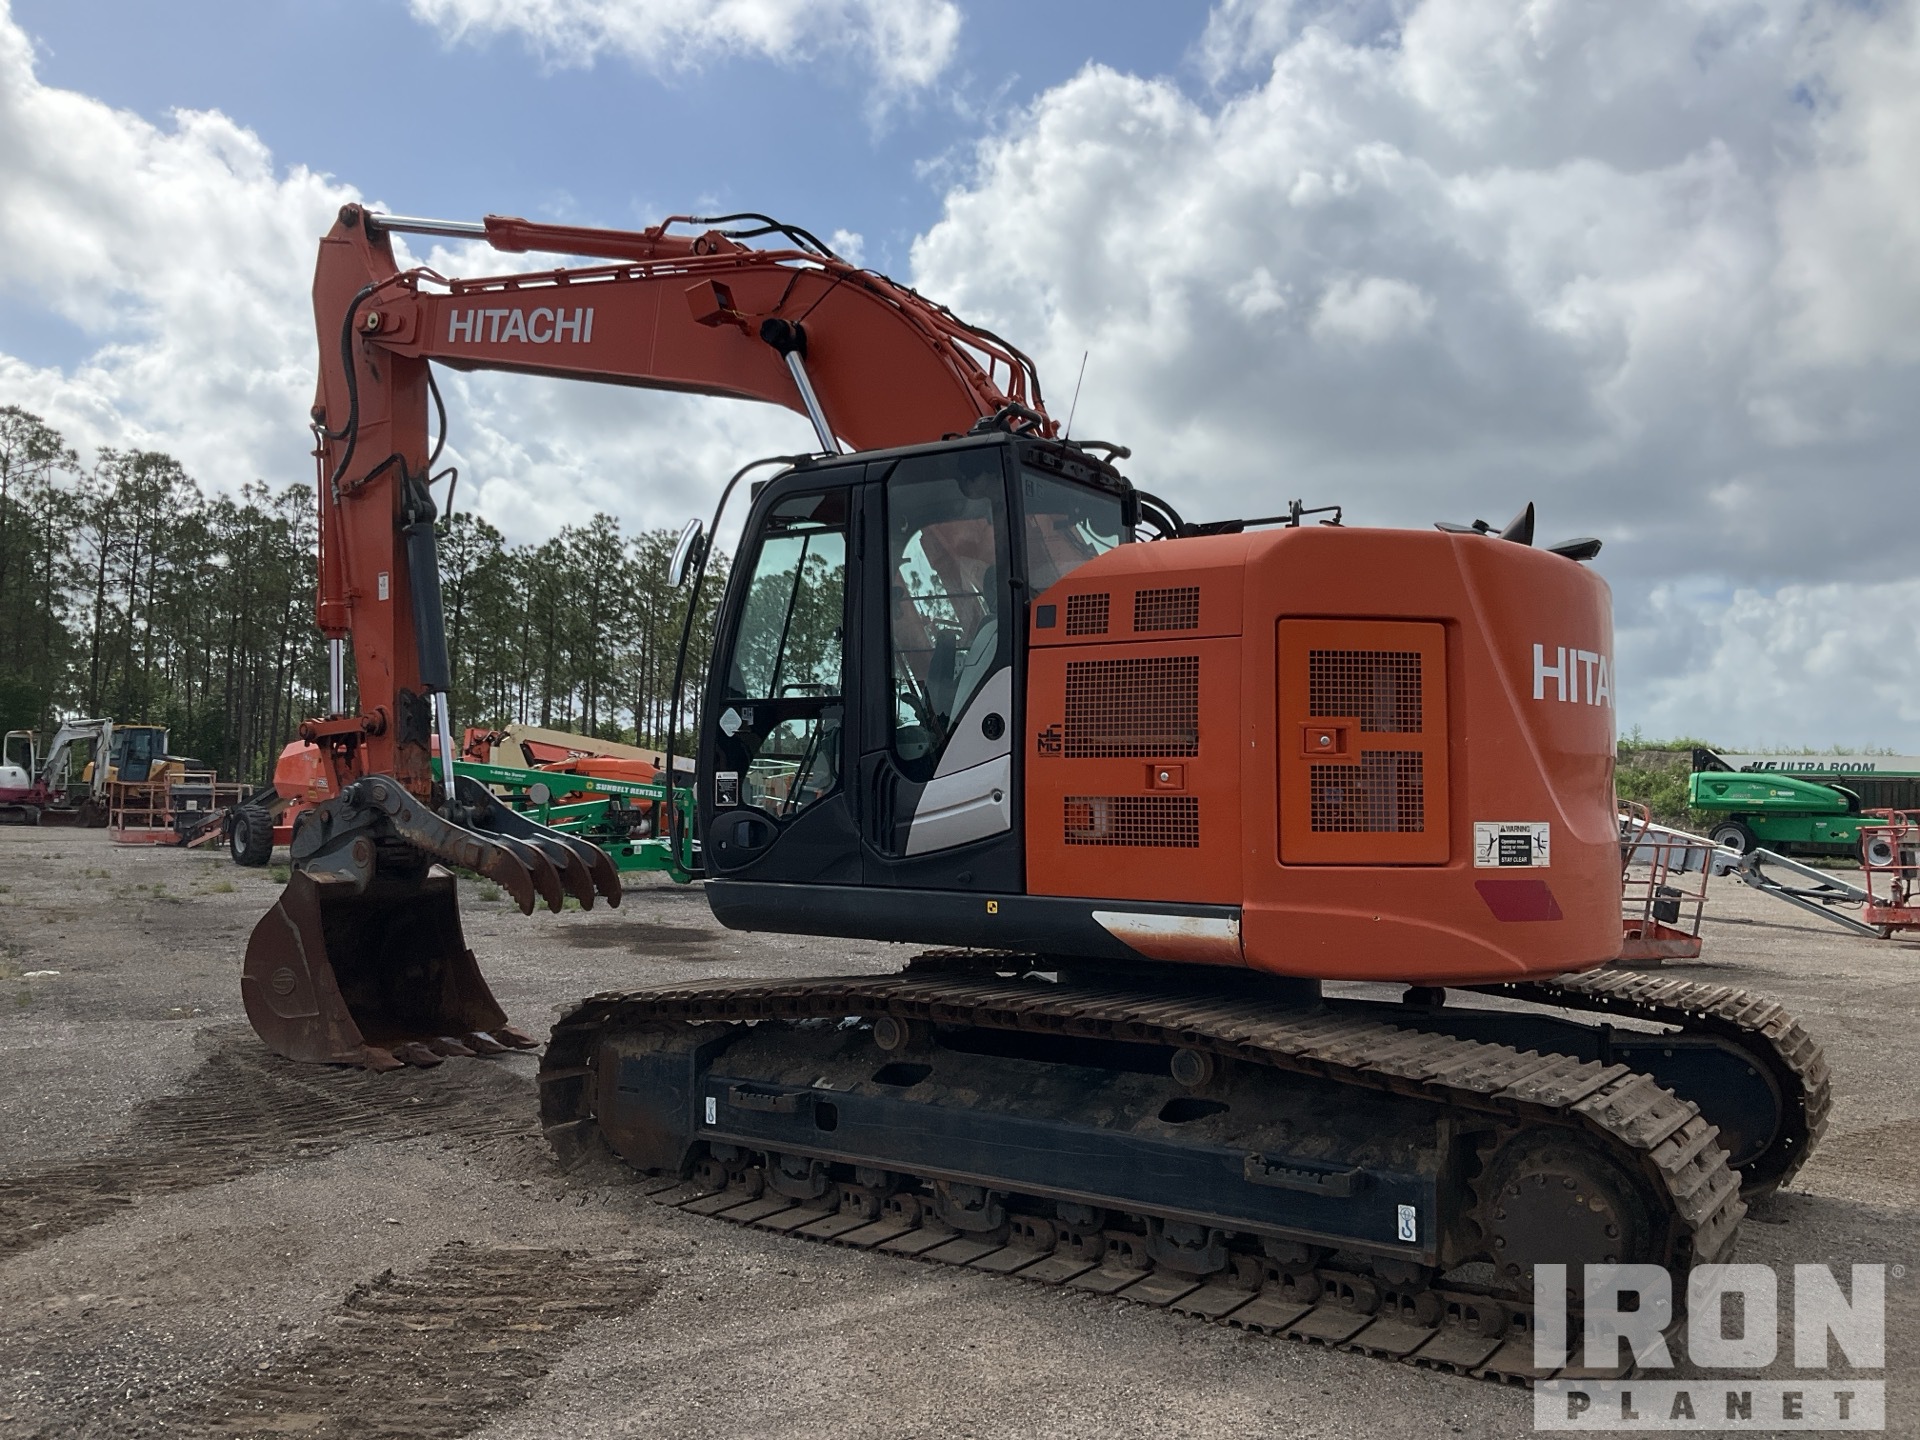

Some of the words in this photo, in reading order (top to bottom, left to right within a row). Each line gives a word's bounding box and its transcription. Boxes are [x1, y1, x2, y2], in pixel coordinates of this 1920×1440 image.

[448, 307, 594, 344] HITACHI
[1781, 762, 1825, 771] ULTRA
[1830, 762, 1876, 772] BOOM
[595, 783, 629, 793] SUNBELT
[630, 787, 663, 798] RENTALS
